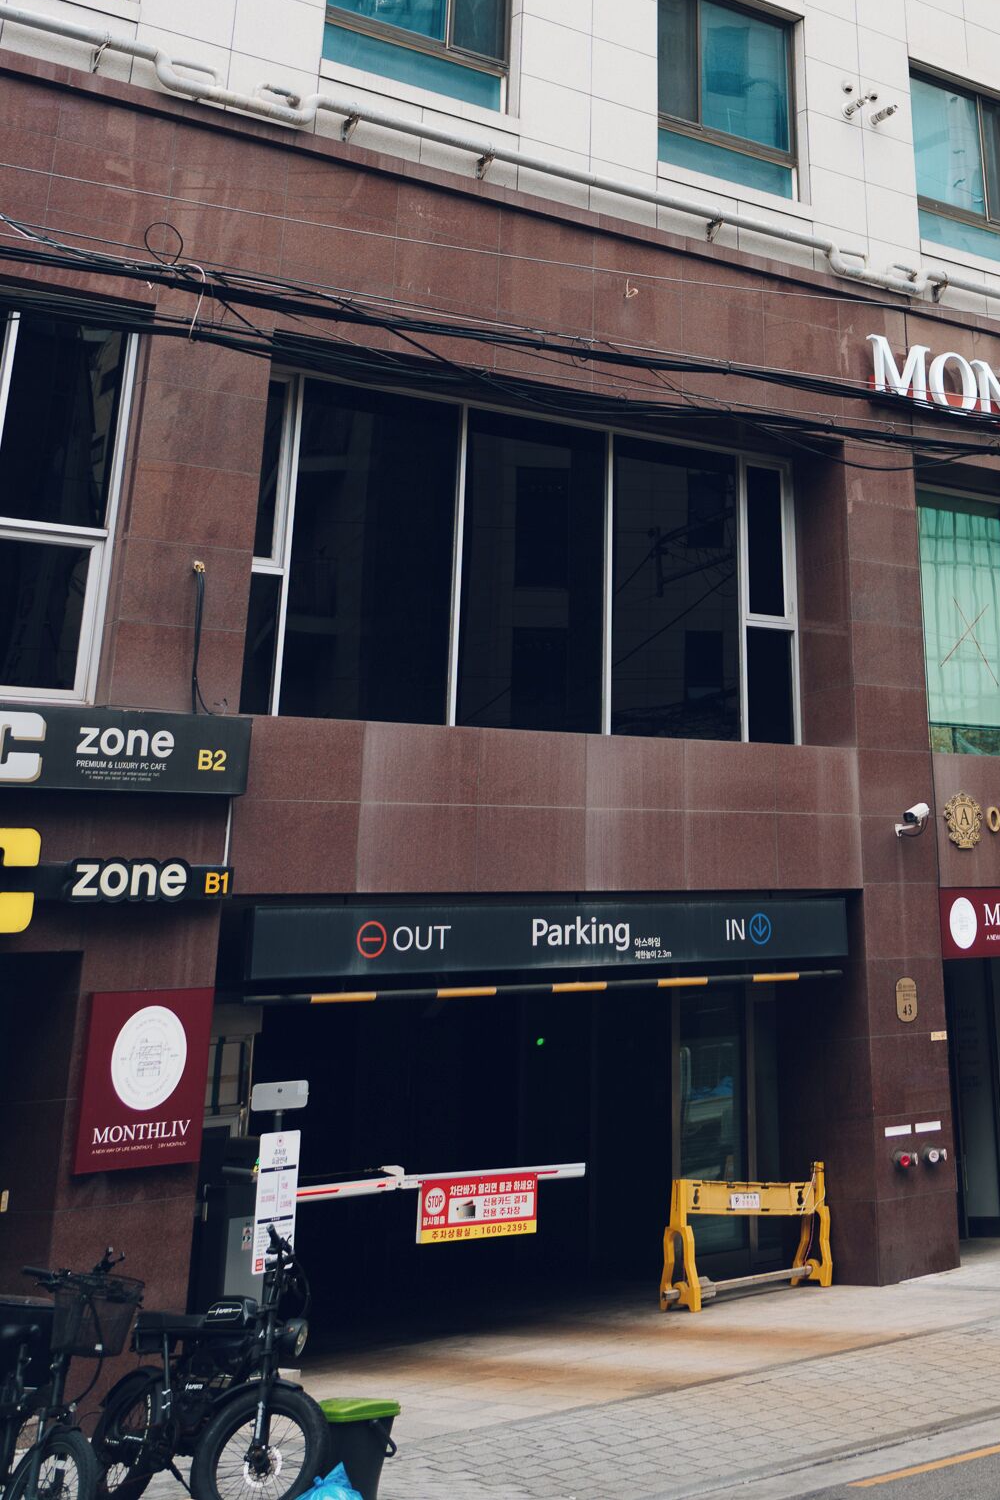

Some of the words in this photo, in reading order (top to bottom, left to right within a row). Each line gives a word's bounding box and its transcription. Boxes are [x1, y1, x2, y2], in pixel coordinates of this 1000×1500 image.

[76, 727, 175, 758] zone
[76, 760, 106, 768] PREMIUM
[114, 761, 139, 770] LUXURY
[140, 762, 149, 770] PC
[150, 762, 167, 771] CAFE
[197, 749, 227, 772] B2
[71, 862, 187, 897] zone
[204, 871, 229, 894] B1
[393, 925, 451, 951] OUT
[532, 916, 630, 951] Parking
[725, 918, 745, 941] IN
[634, 937, 661, 947] 아스하임
[635, 950, 657, 959] 제한높이
[657, 950, 672, 959] 2.3m
[902, 1004, 912, 1015] 43
[92, 1119, 191, 1145] MONTHLIV
[449, 1184, 476, 1196] 차단바가
[478, 1182, 498, 1193] 열리면
[499, 1181, 512, 1192] 통과
[514, 1180, 535, 1191] 하세요!
[427, 1195, 444, 1209] STOP
[483, 1195, 511, 1207] 신용카드
[513, 1194, 528, 1204] 결제
[483, 1208, 497, 1218] 전용
[499, 1206, 520, 1216] 주차장
[423, 1216, 445, 1227] 잠시멈춤
[432, 1228, 471, 1240] 주차상황실
[481, 1222, 528, 1235] 1600-2395
